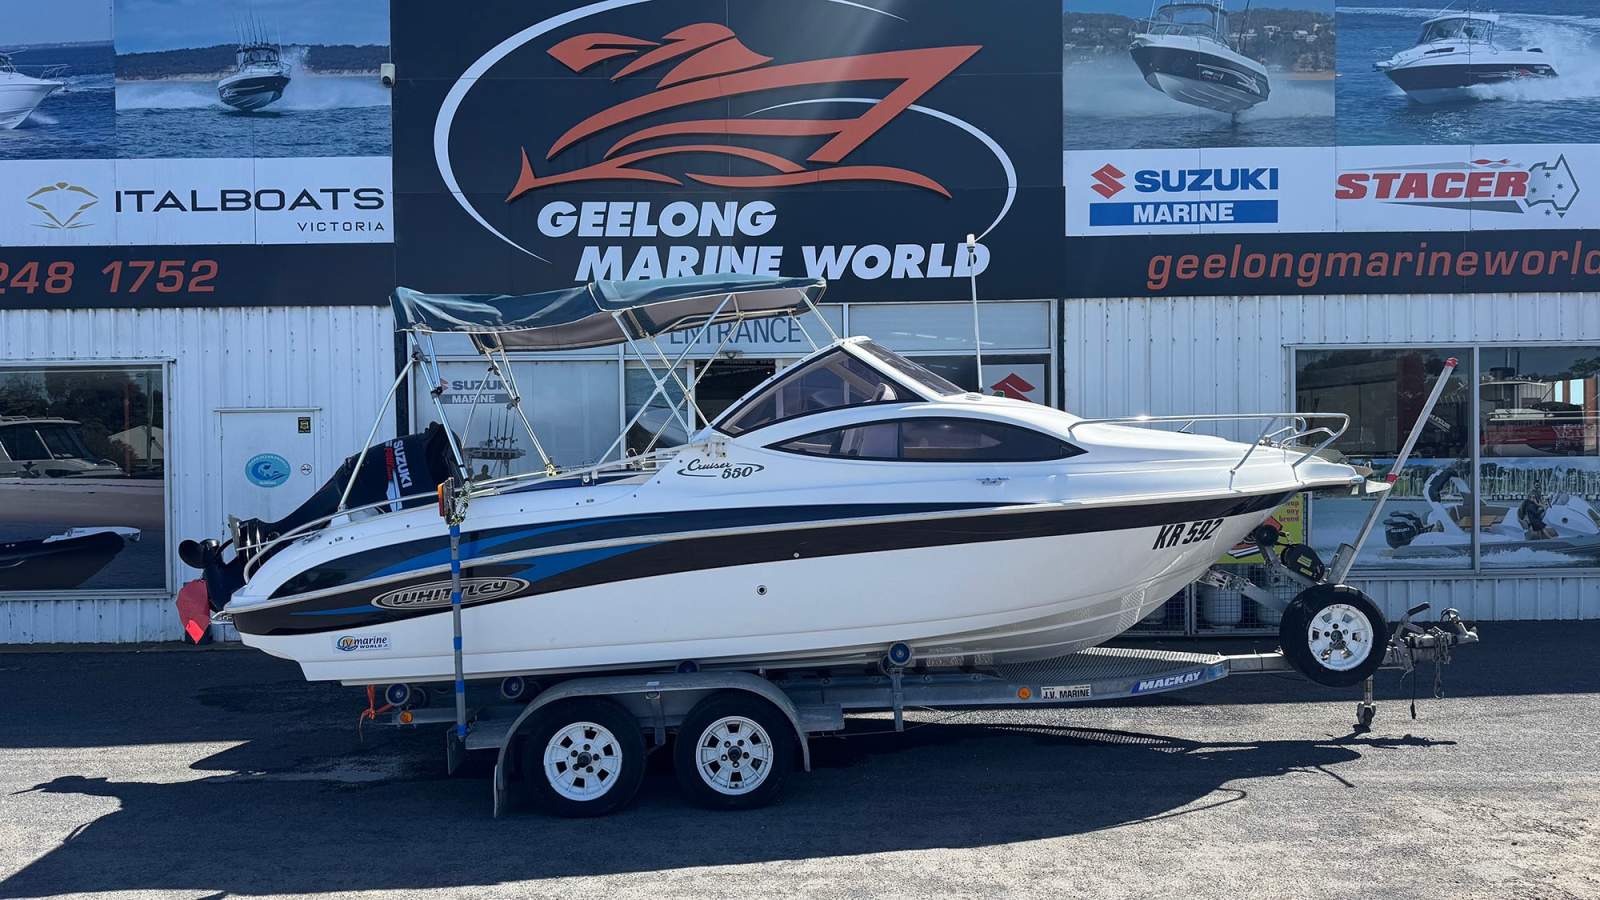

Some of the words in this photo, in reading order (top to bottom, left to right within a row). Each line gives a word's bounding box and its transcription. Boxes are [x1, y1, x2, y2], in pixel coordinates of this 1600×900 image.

[1134, 168, 1279, 193] SUZUKI
[1334, 171, 1529, 200] STACER
[115, 188, 385, 213] ITALBOATS
[1133, 203, 1235, 223] MARINE
[297, 221, 385, 232] VICTORIA
[537, 200, 777, 238] GEELONG
[574, 245, 784, 282] MARINE
[802, 243, 991, 281] WORLD
[102, 260, 219, 293] 1752
[393, 440, 413, 488] SUZUKI
[687, 458, 733, 471] Cruiser
[1152, 524, 1186, 550] KR
[1182, 518, 1225, 545] 592
[354, 636, 388, 645] marine
[1138, 671, 1201, 691] MACKAY
[1043, 690, 1057, 700] J.V.
[1059, 688, 1091, 699] MARINE
